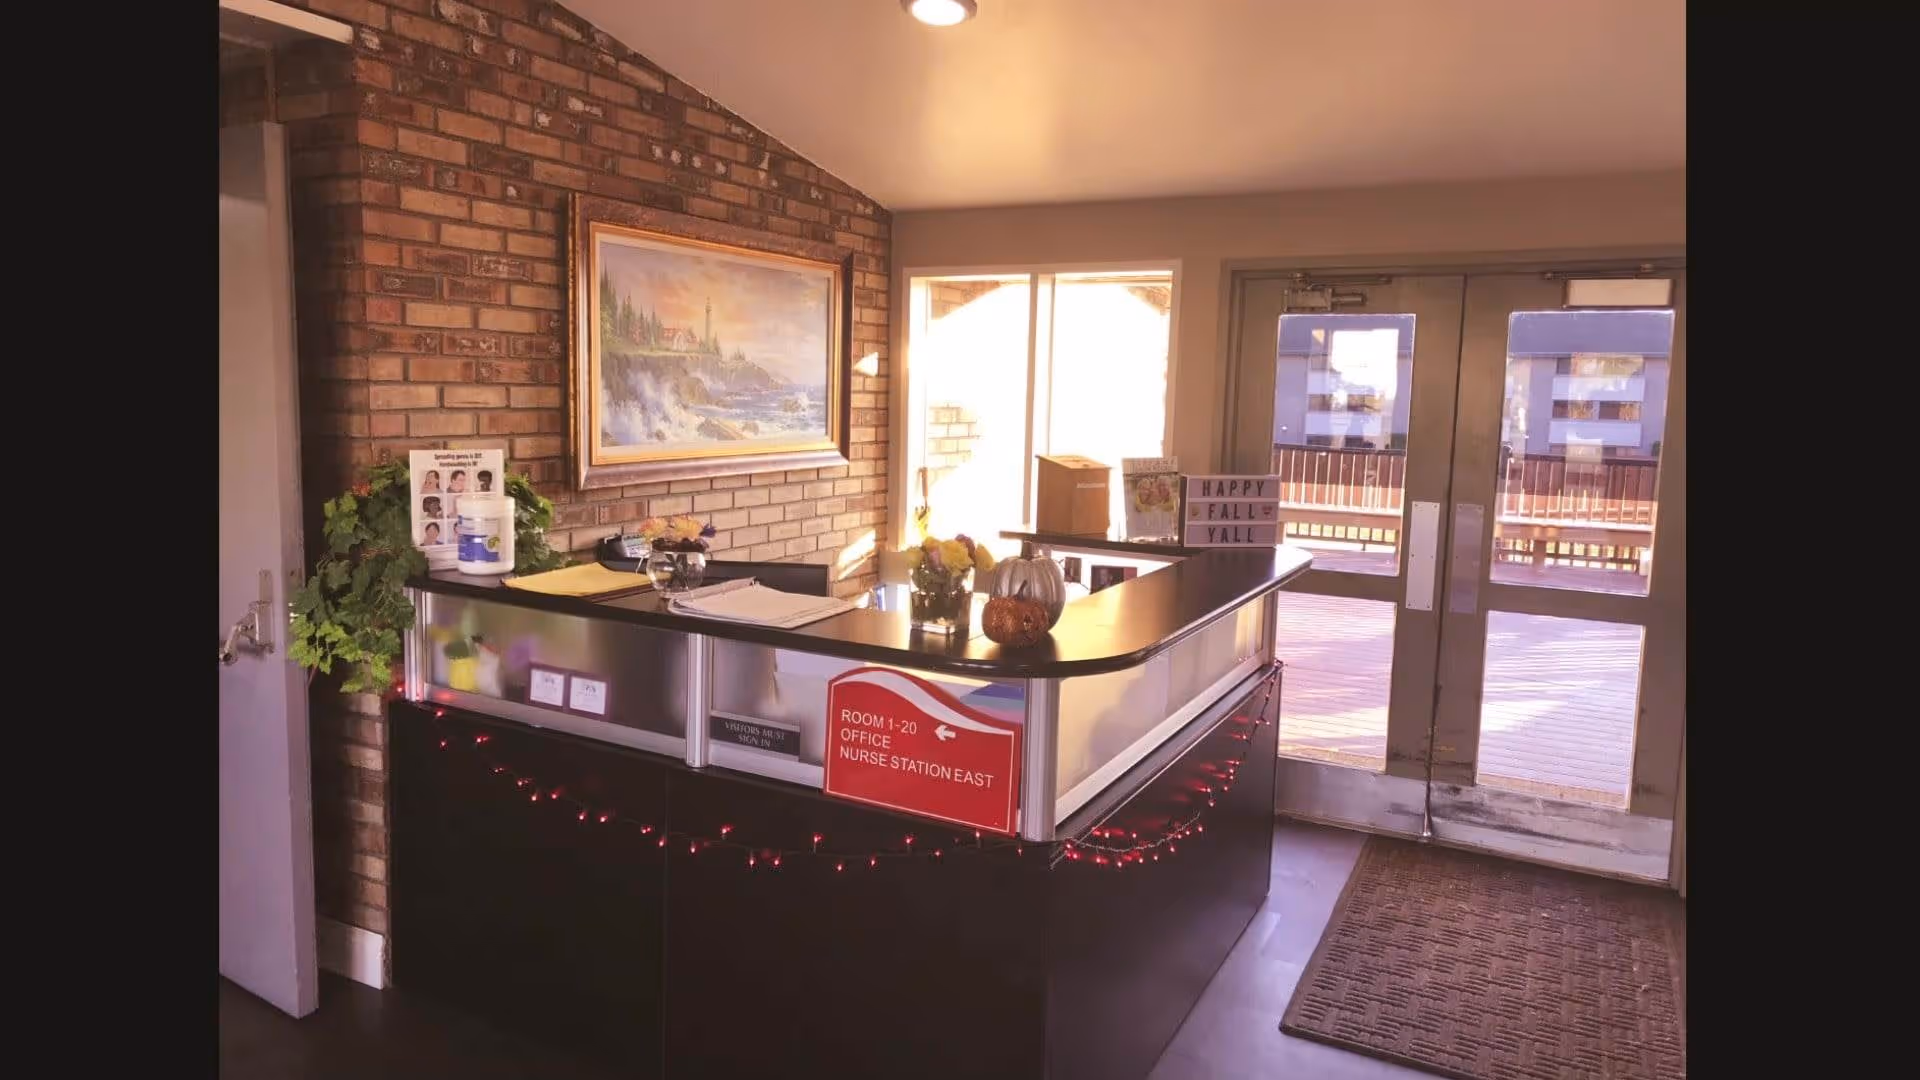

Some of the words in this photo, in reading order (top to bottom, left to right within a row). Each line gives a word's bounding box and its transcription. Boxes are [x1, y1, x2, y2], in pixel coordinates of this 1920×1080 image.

[1202, 480, 1264, 496] HAPPY
[1208, 503, 1255, 520] FALL
[1208, 526, 1254, 543] YALL
[725, 721, 760, 736] VISITORS
[762, 728, 785, 740] MUST
[841, 709, 884, 729] ROOM
[887, 718, 917, 735] 1-20
[738, 734, 759, 745] SIGN
[761, 738, 771, 747] IN
[840, 727, 891, 749] OFFICE
[840, 746, 888, 767] NURSE
[890, 755, 951, 779] STATION
[954, 768, 995, 788] EAST
